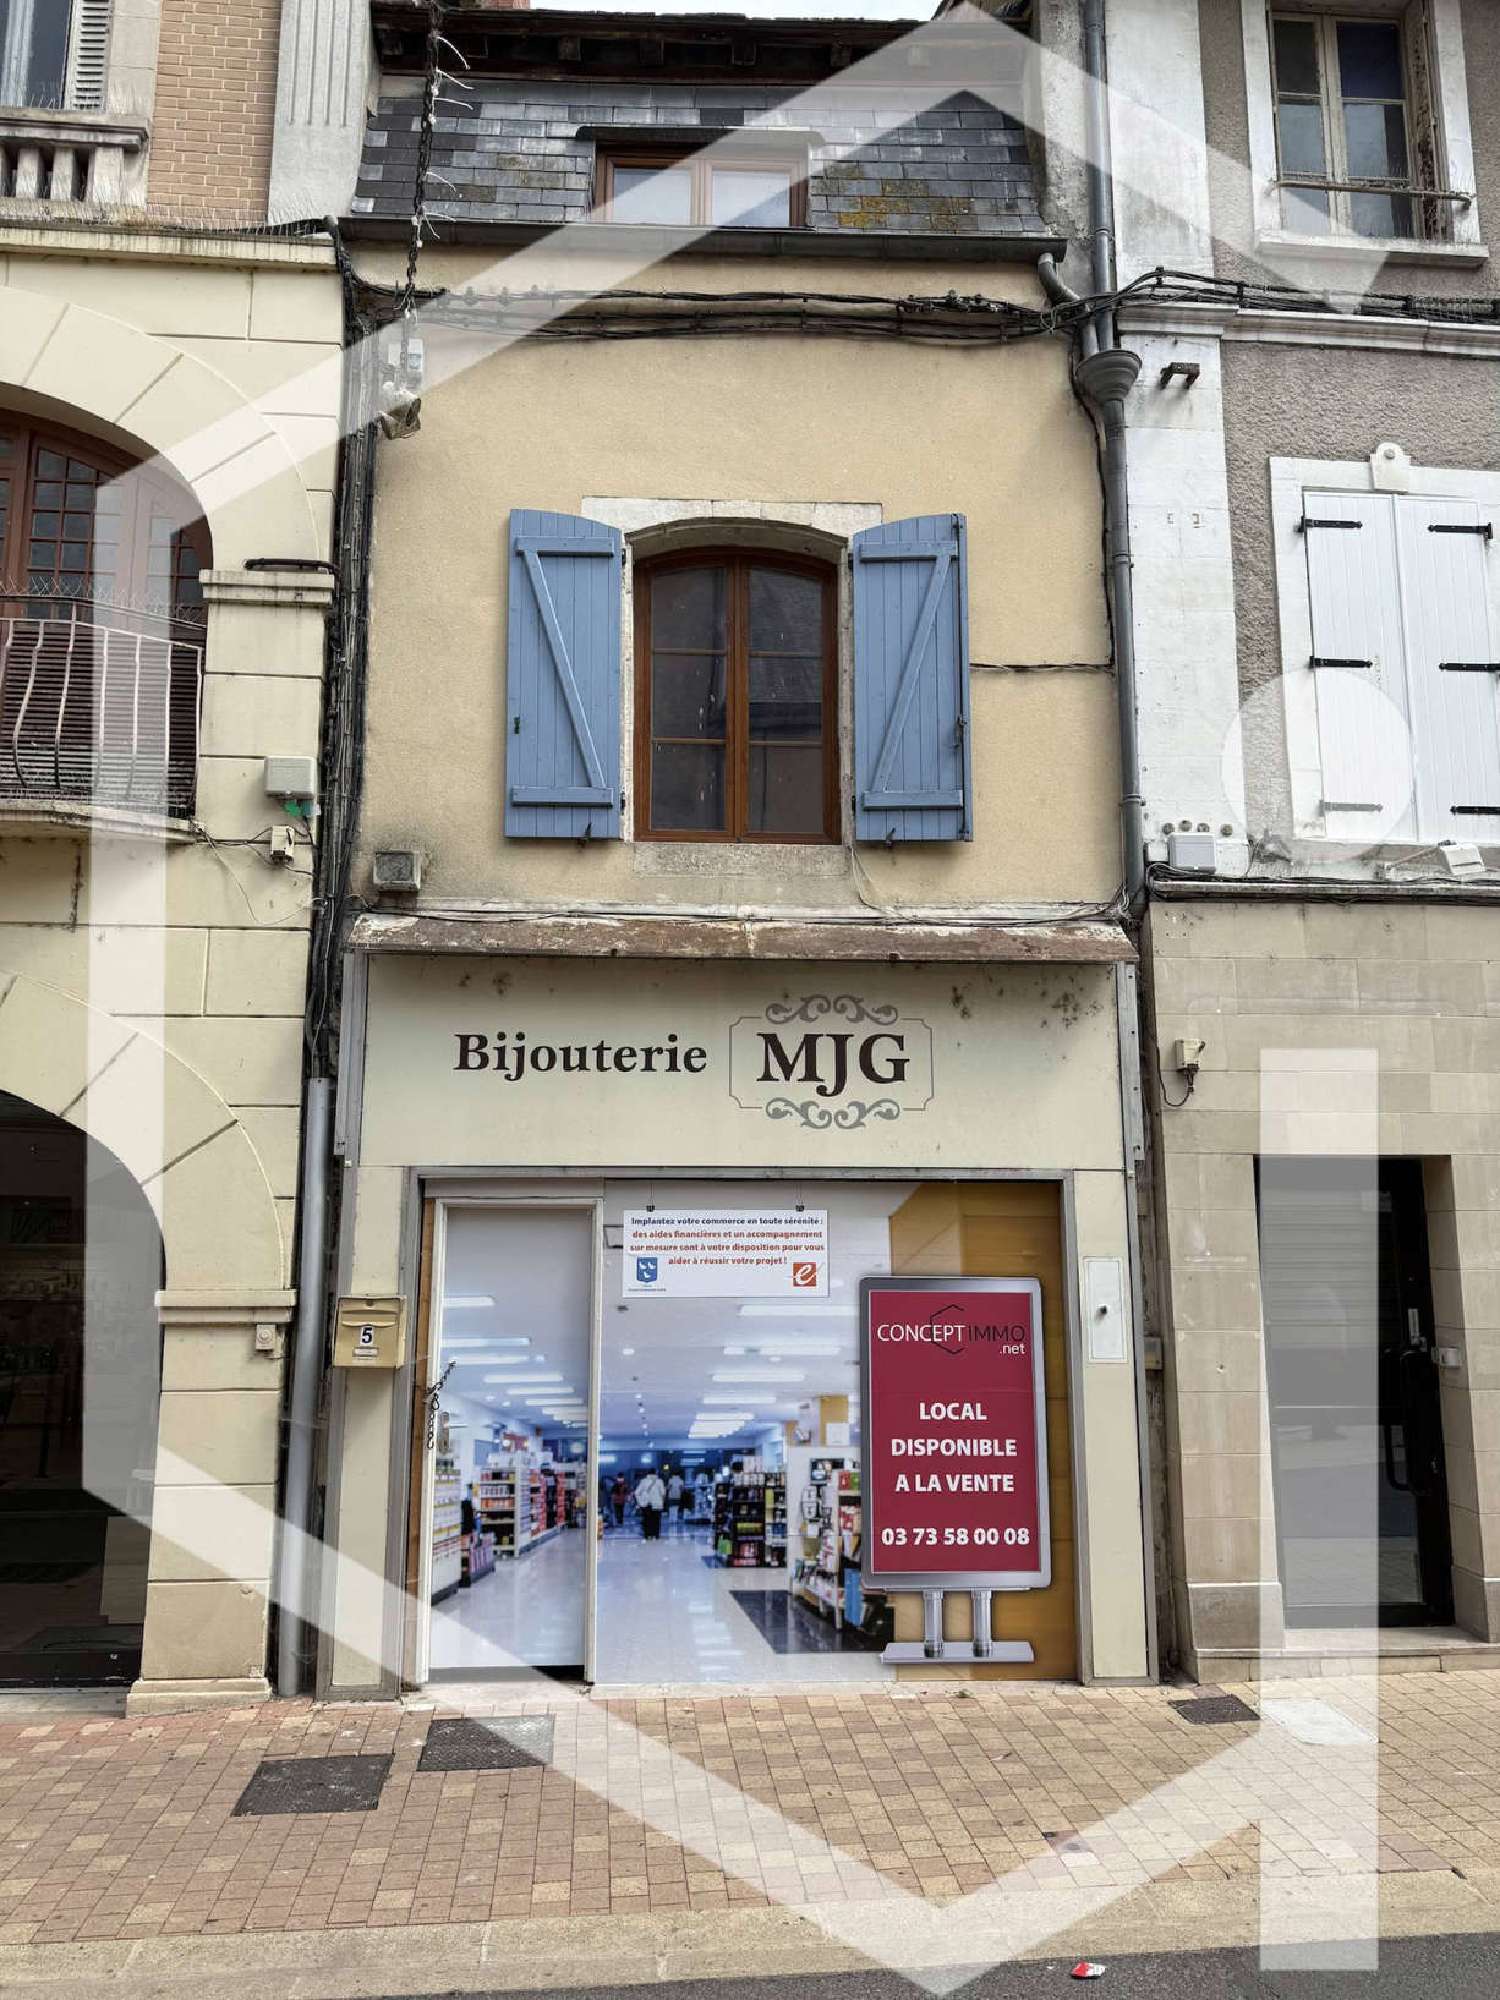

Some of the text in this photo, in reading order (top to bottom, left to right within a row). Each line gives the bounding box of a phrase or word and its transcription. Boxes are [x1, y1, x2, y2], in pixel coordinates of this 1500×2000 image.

[453, 1031, 910, 1097] Bijouterie MJG
[631, 1217, 675, 1226] Implantez
[759, 1217, 782, 1225] toute
[746, 1231, 823, 1239] accompagnement
[679, 1243, 698, 1251] sont
[700, 1243, 706, 1251] à
[732, 1243, 780, 1252] disposition
[782, 1244, 802, 1252] pour
[668, 1257, 691, 1265] aider
[691, 1257, 698, 1265] à
[700, 1256, 729, 1265] réussir
[731, 1257, 755, 1265] votre
[361, 1326, 373, 1344] 5
[999, 1343, 1026, 1355] .net
[919, 1402, 987, 1421] LOCAL
[891, 1438, 1018, 1458] DISPONIBLE
[895, 1473, 1015, 1493] A LA VENTE
[881, 1526, 1030, 1546] 03 73 58 00 08
